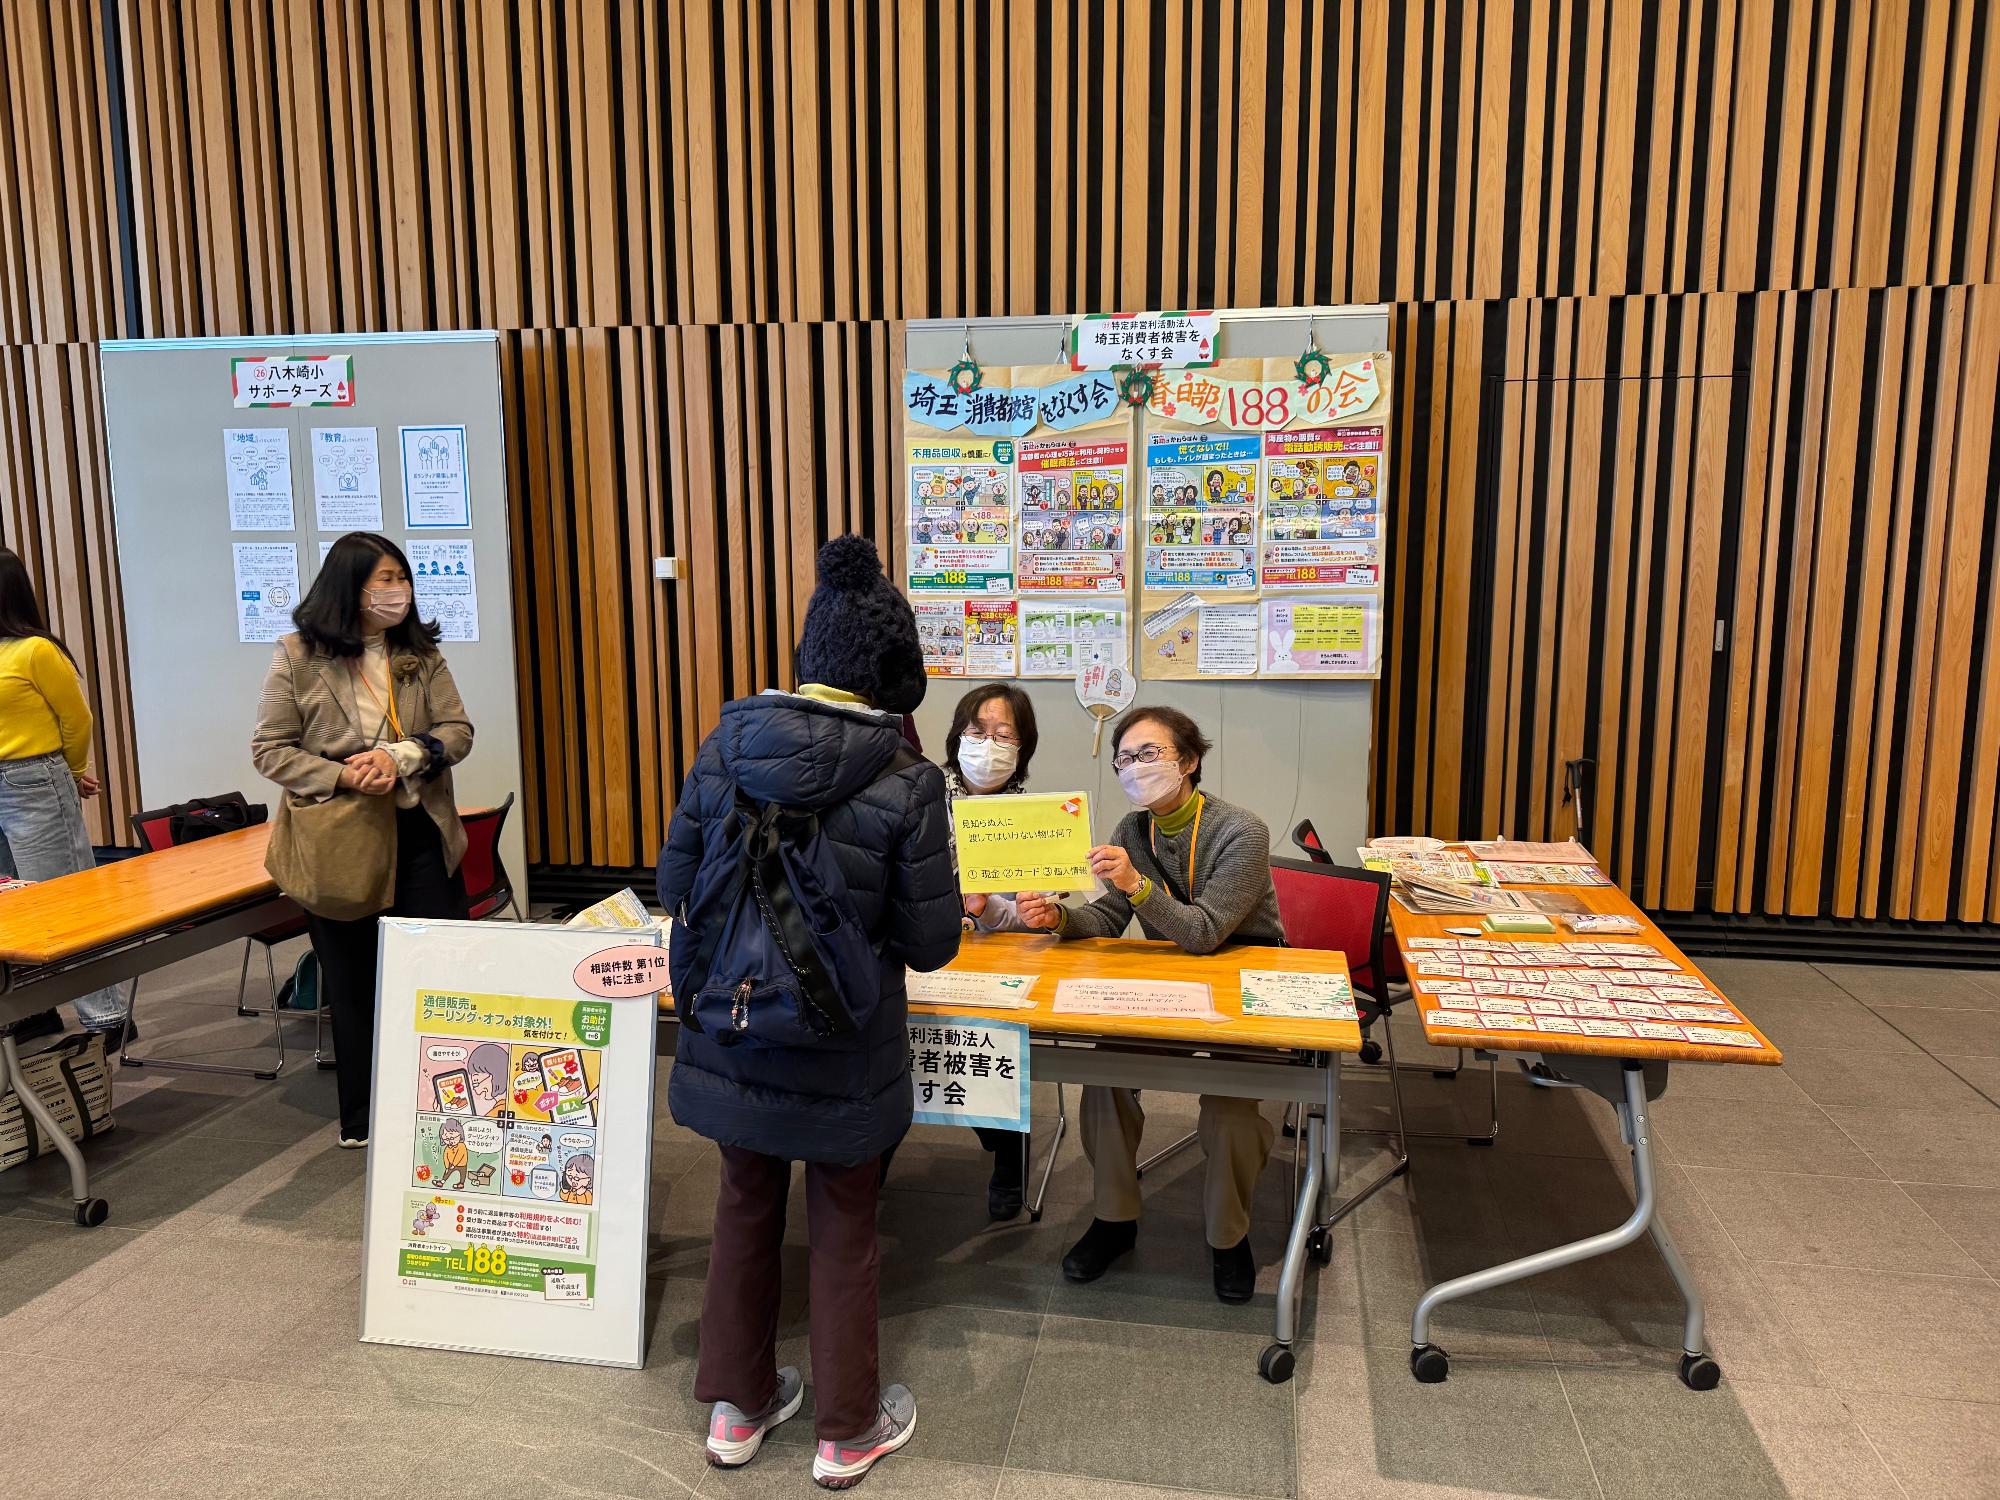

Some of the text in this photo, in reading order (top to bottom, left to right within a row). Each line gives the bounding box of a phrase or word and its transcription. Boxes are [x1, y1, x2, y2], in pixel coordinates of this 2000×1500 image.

[1095, 330, 1200, 346] 埼玉消費者被害を
[1121, 347, 1174, 361] なくす会
[248, 382, 332, 399] サポーターズ
[1178, 442, 1229, 454] 慌てないで!!
[1284, 441, 1379, 453] 電話勧誘販売にご注意!!
[944, 571, 966, 584] 188
[1174, 573, 1190, 582] 188
[1297, 568, 1316, 579] 188
[1046, 576, 1062, 586] 188
[962, 818, 1014, 829] 見知らぬ人に
[968, 829, 1073, 843] 渡してはいけない物は何?
[591, 956, 666, 975] 相談件数 第1位
[602, 971, 652, 987] 特に注意!
[423, 995, 477, 1011] 通信販売は
[423, 1008, 552, 1029] クーリング・オフの対象外!
[581, 1015, 606, 1025] お助け
[523, 1029, 568, 1041] 気を付けて!
[581, 1024, 606, 1032] かわらばん
[910, 1027, 996, 1050] 利活動法人
[918, 1079, 967, 1106] す会
[466, 1216, 552, 1232] 受け取った商品はすぐに確認する!
[407, 1242, 447, 1251] 消費者ホットライン
[445, 1257, 466, 1271] TEL
[464, 1247, 507, 1275] 188
